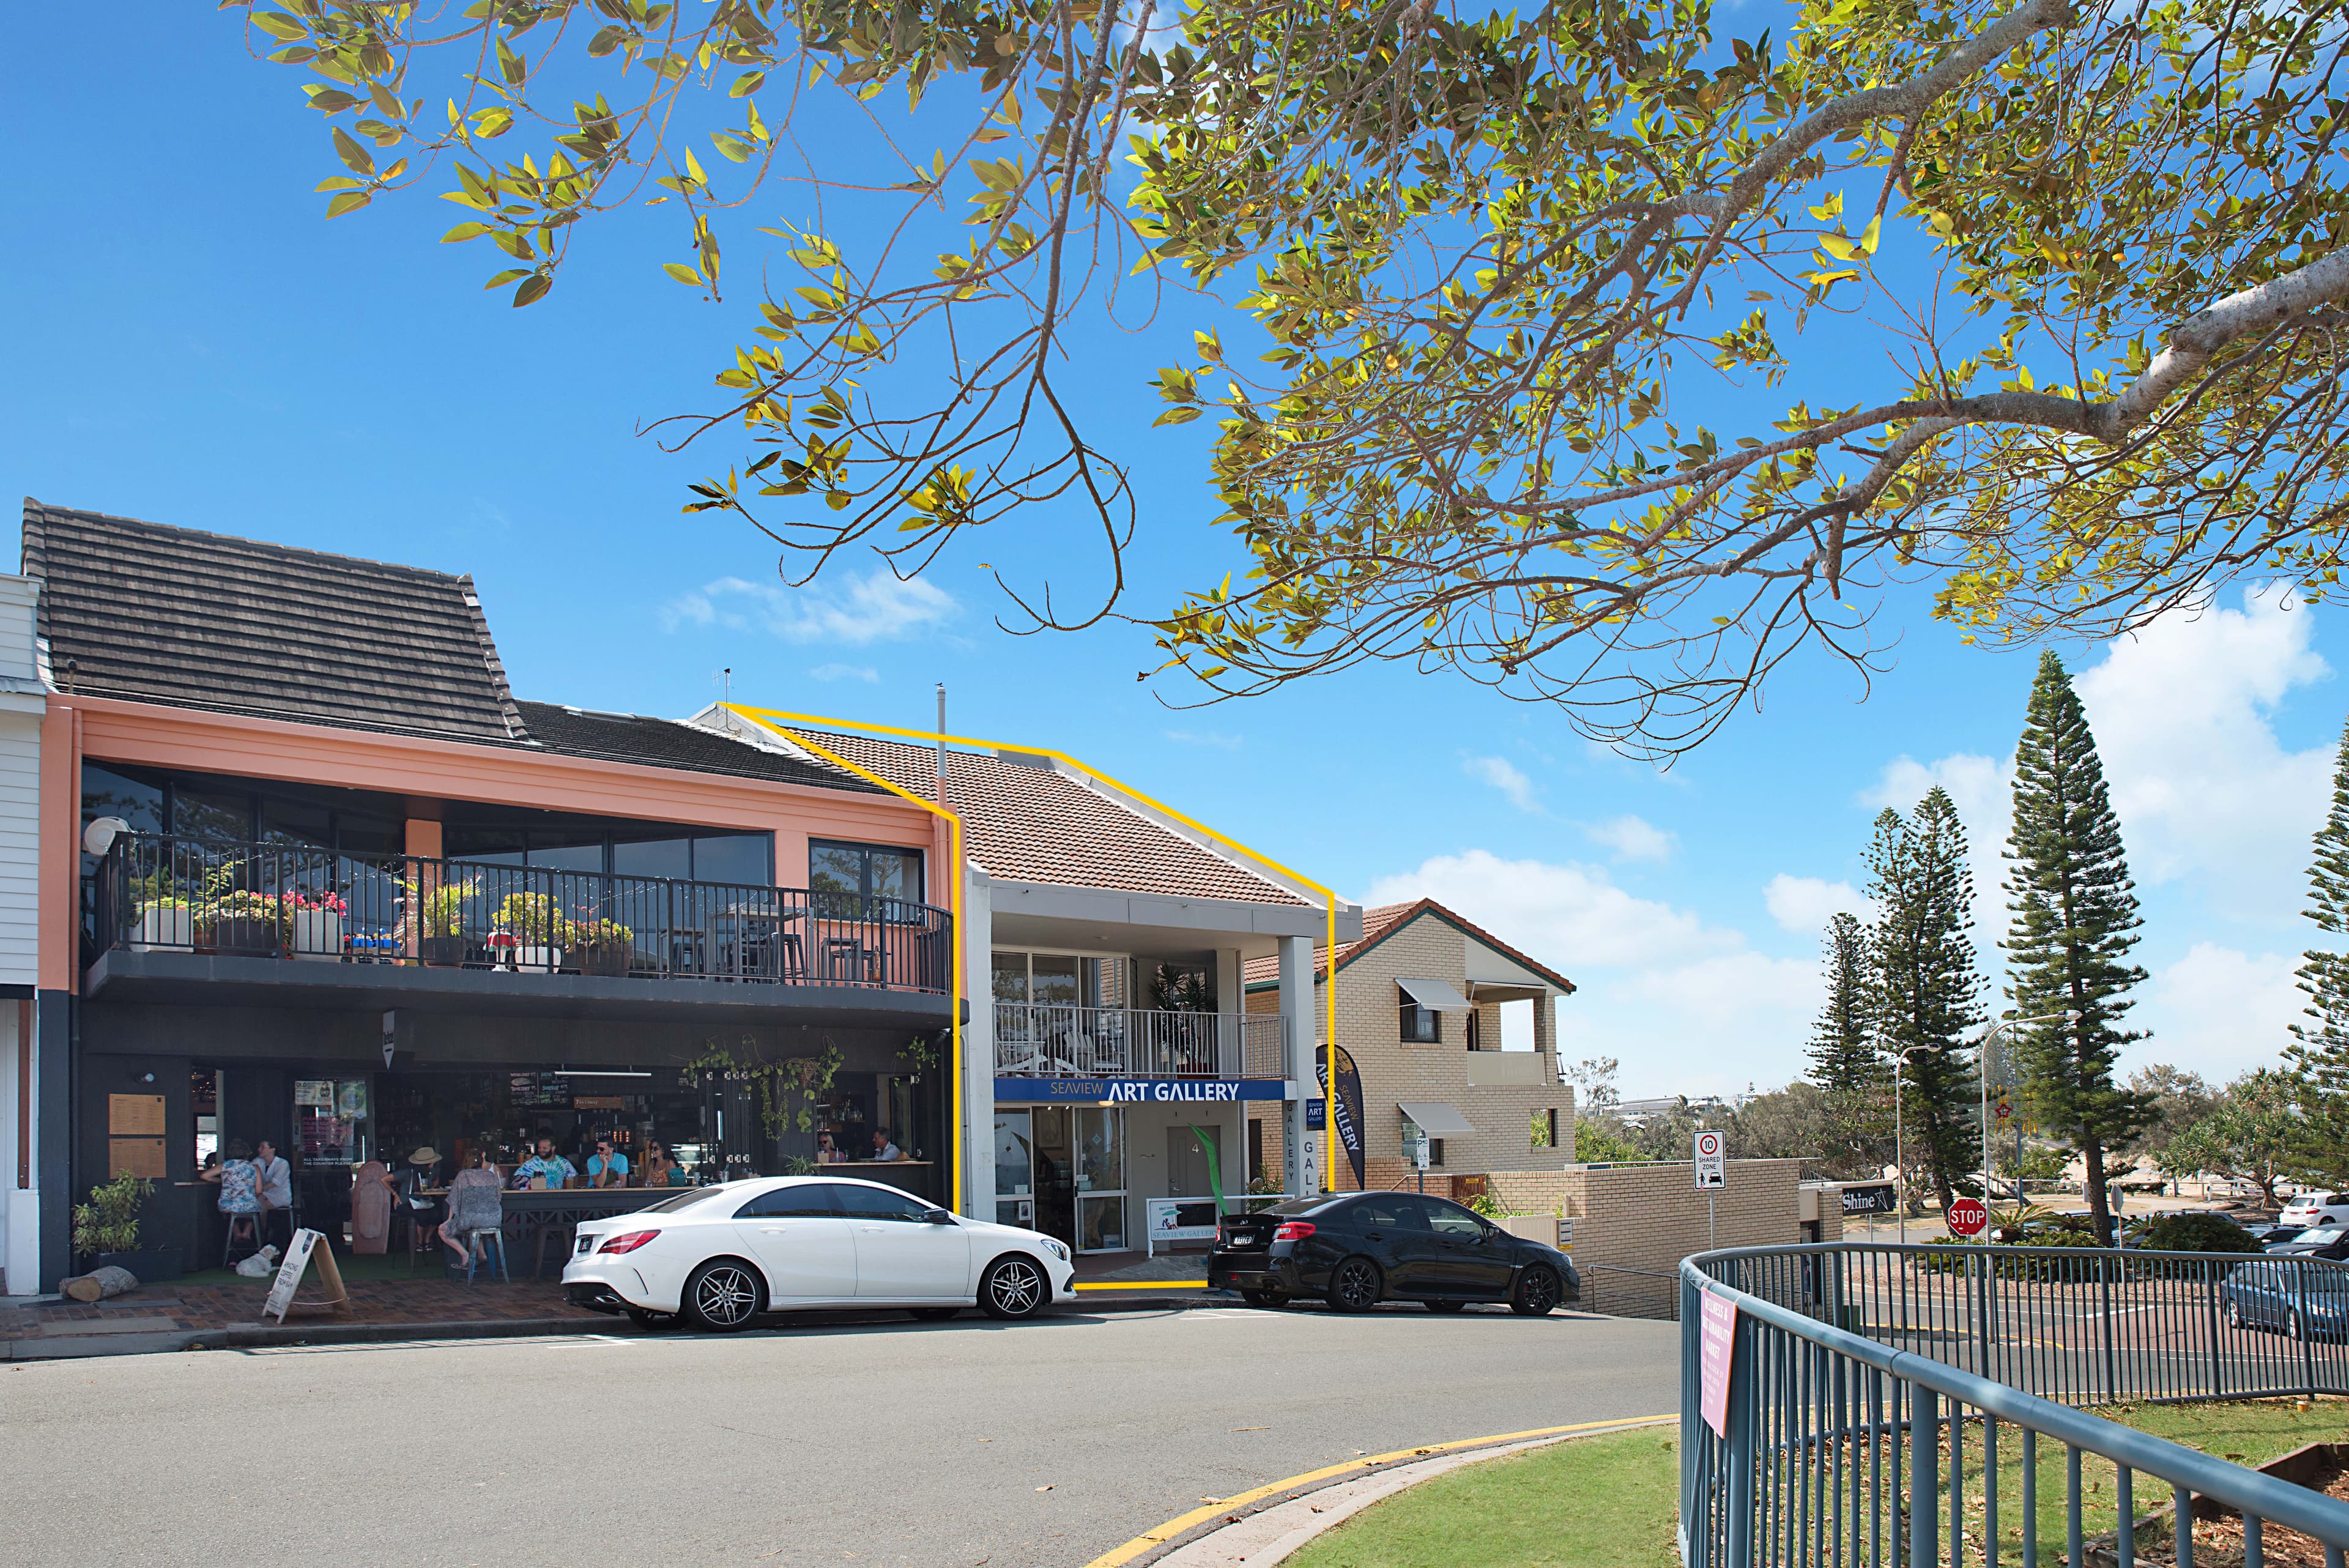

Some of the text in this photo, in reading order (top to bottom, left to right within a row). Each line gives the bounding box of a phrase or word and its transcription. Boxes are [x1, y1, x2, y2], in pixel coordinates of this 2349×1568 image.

[1316, 1063, 1336, 1088] AR
[1051, 1082, 1239, 1101] SEAVIEW ART GALLERY
[1339, 1085, 1359, 1120] SEAVIEW
[1192, 1143, 1199, 1153] 4
[1705, 1140, 1713, 1149] 10
[1842, 1192, 1875, 1212] Shine
[1951, 1210, 1985, 1224] STOP
[1705, 1296, 1728, 1321] WELLNESS &
